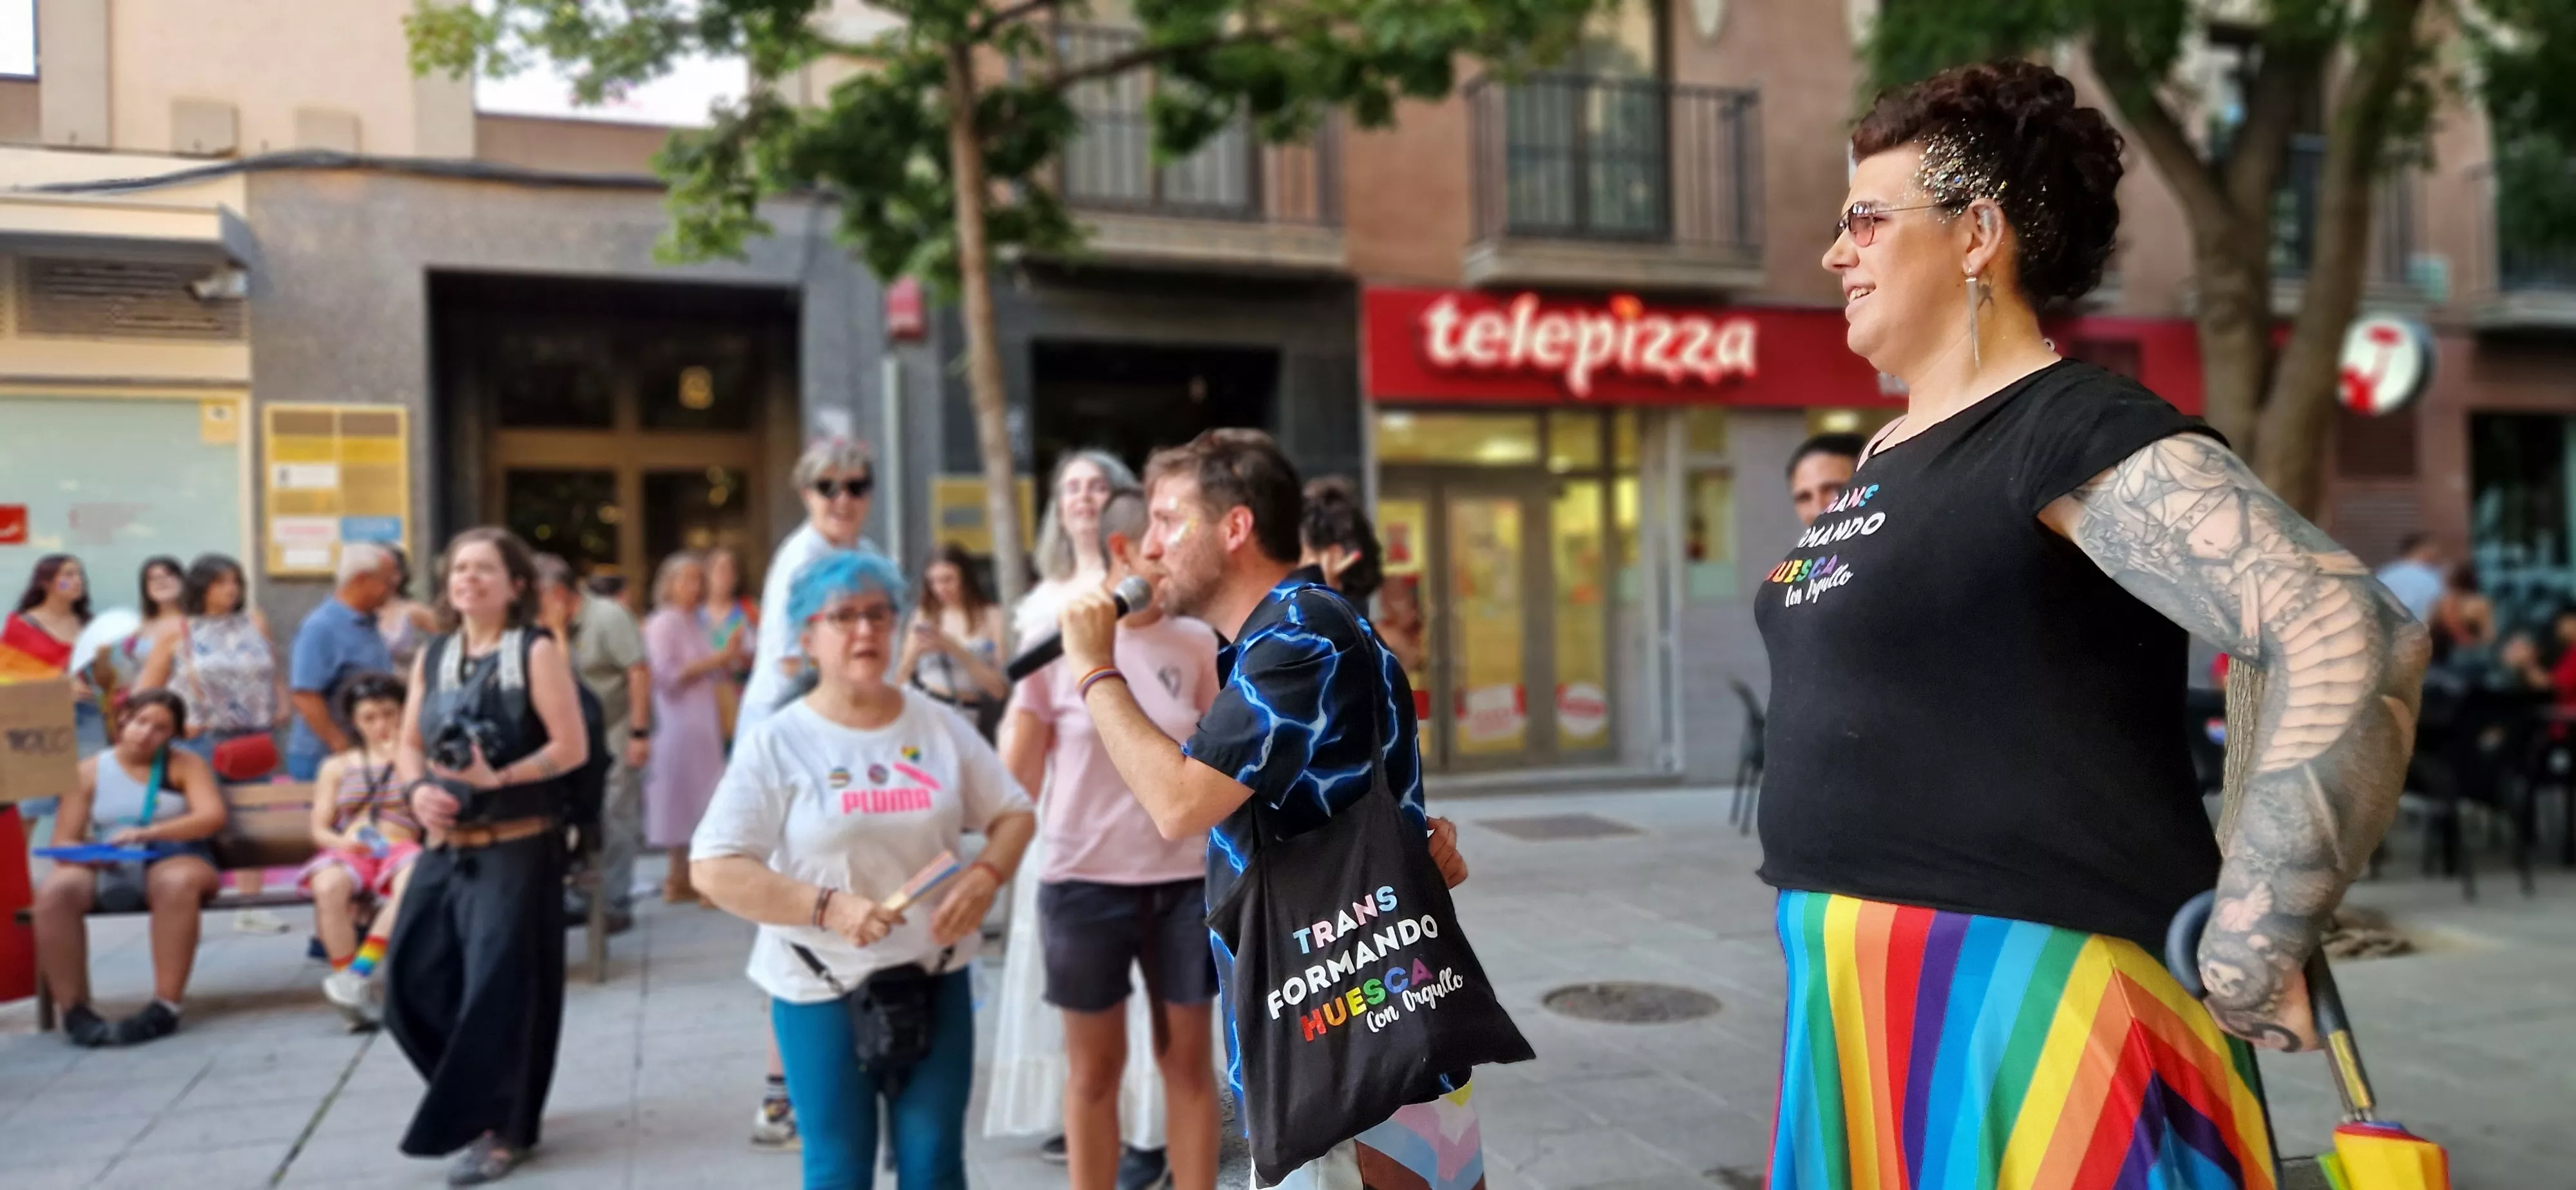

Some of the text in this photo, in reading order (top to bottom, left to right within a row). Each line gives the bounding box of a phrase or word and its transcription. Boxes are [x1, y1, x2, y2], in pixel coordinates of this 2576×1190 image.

[1422, 293, 1756, 397] telepizza
[842, 788, 932, 814] PLUMA
[1293, 885, 1397, 954] TRANS
[1267, 914, 1438, 1020] FORMANDO
[1300, 958, 1432, 1042] HUESCA
[1367, 967, 1463, 1033] Con Orgullo
